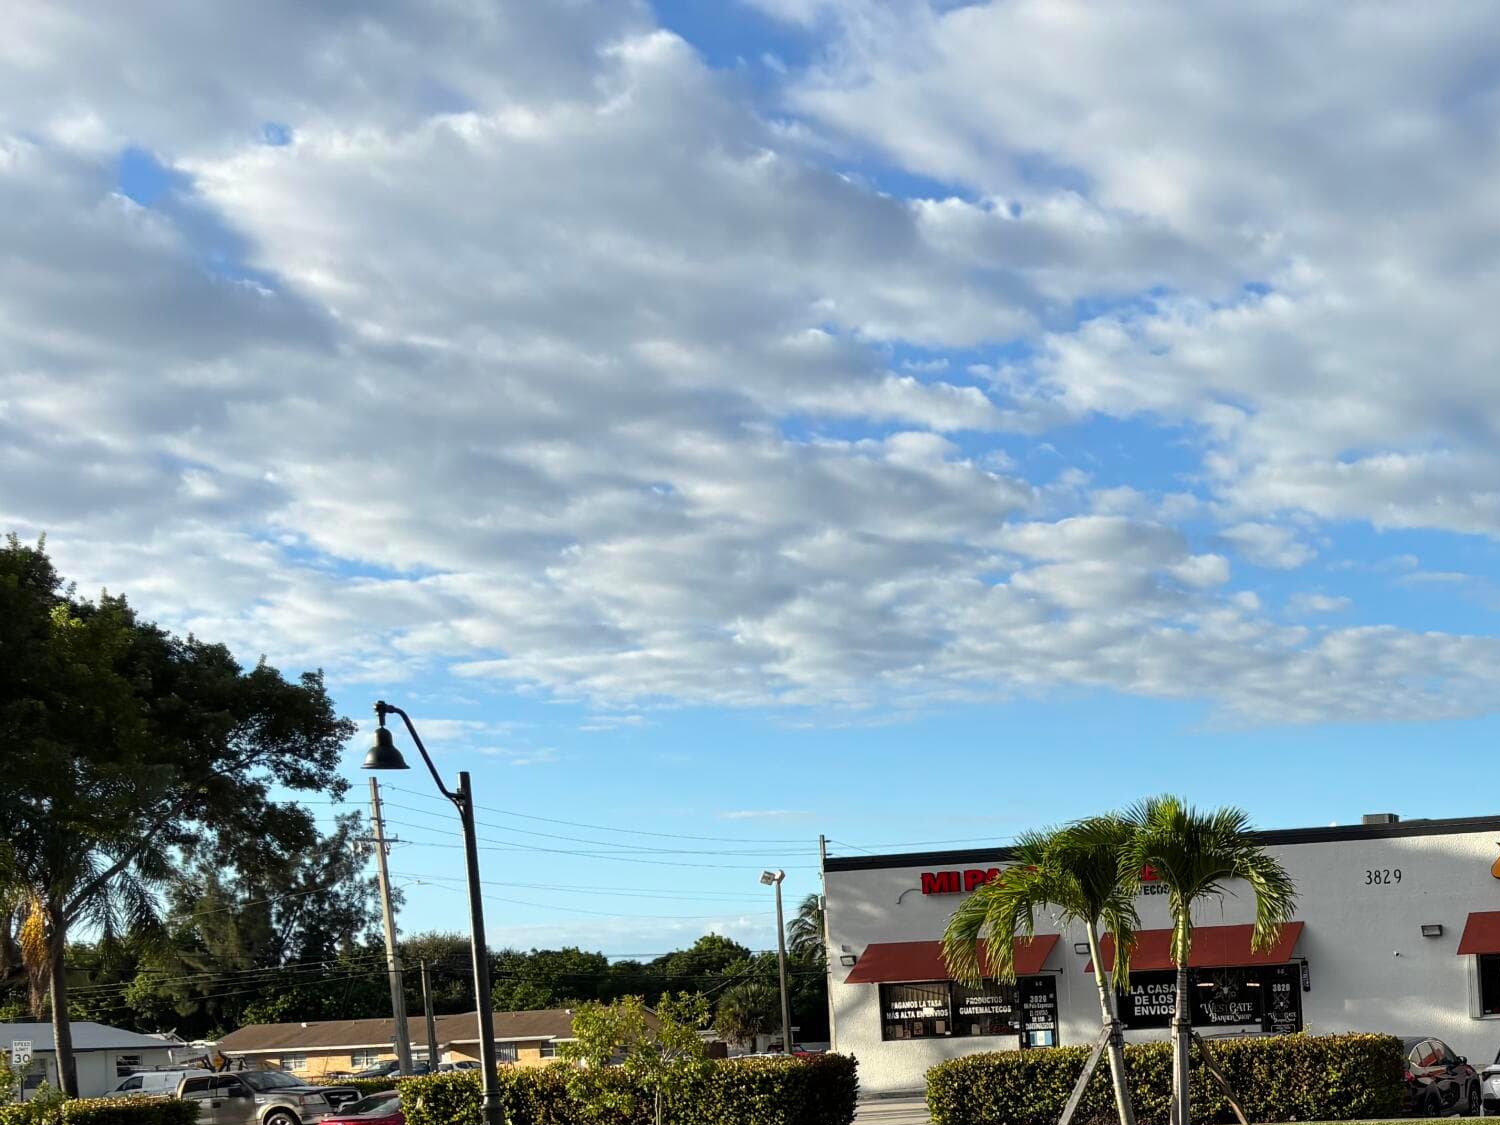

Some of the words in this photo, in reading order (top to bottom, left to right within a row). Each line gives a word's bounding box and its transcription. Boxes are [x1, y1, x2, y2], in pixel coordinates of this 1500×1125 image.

[920, 871, 961, 894] MI
[1365, 869, 1402, 885] 3829
[1130, 985, 1144, 995] LA
[1147, 983, 1177, 994] CASA
[918, 1000, 927, 1008] LA
[927, 999, 943, 1007] TASA
[965, 996, 1003, 1005] PRODUCTOS
[1134, 995, 1149, 1005] DE
[1152, 994, 1174, 1004] LOS
[900, 1010, 916, 1019] ALTA
[959, 1004, 1012, 1015] GUATEMALTECOS
[1134, 1005, 1176, 1016] ENVIOS
[14, 1054, 30, 1063] 30
